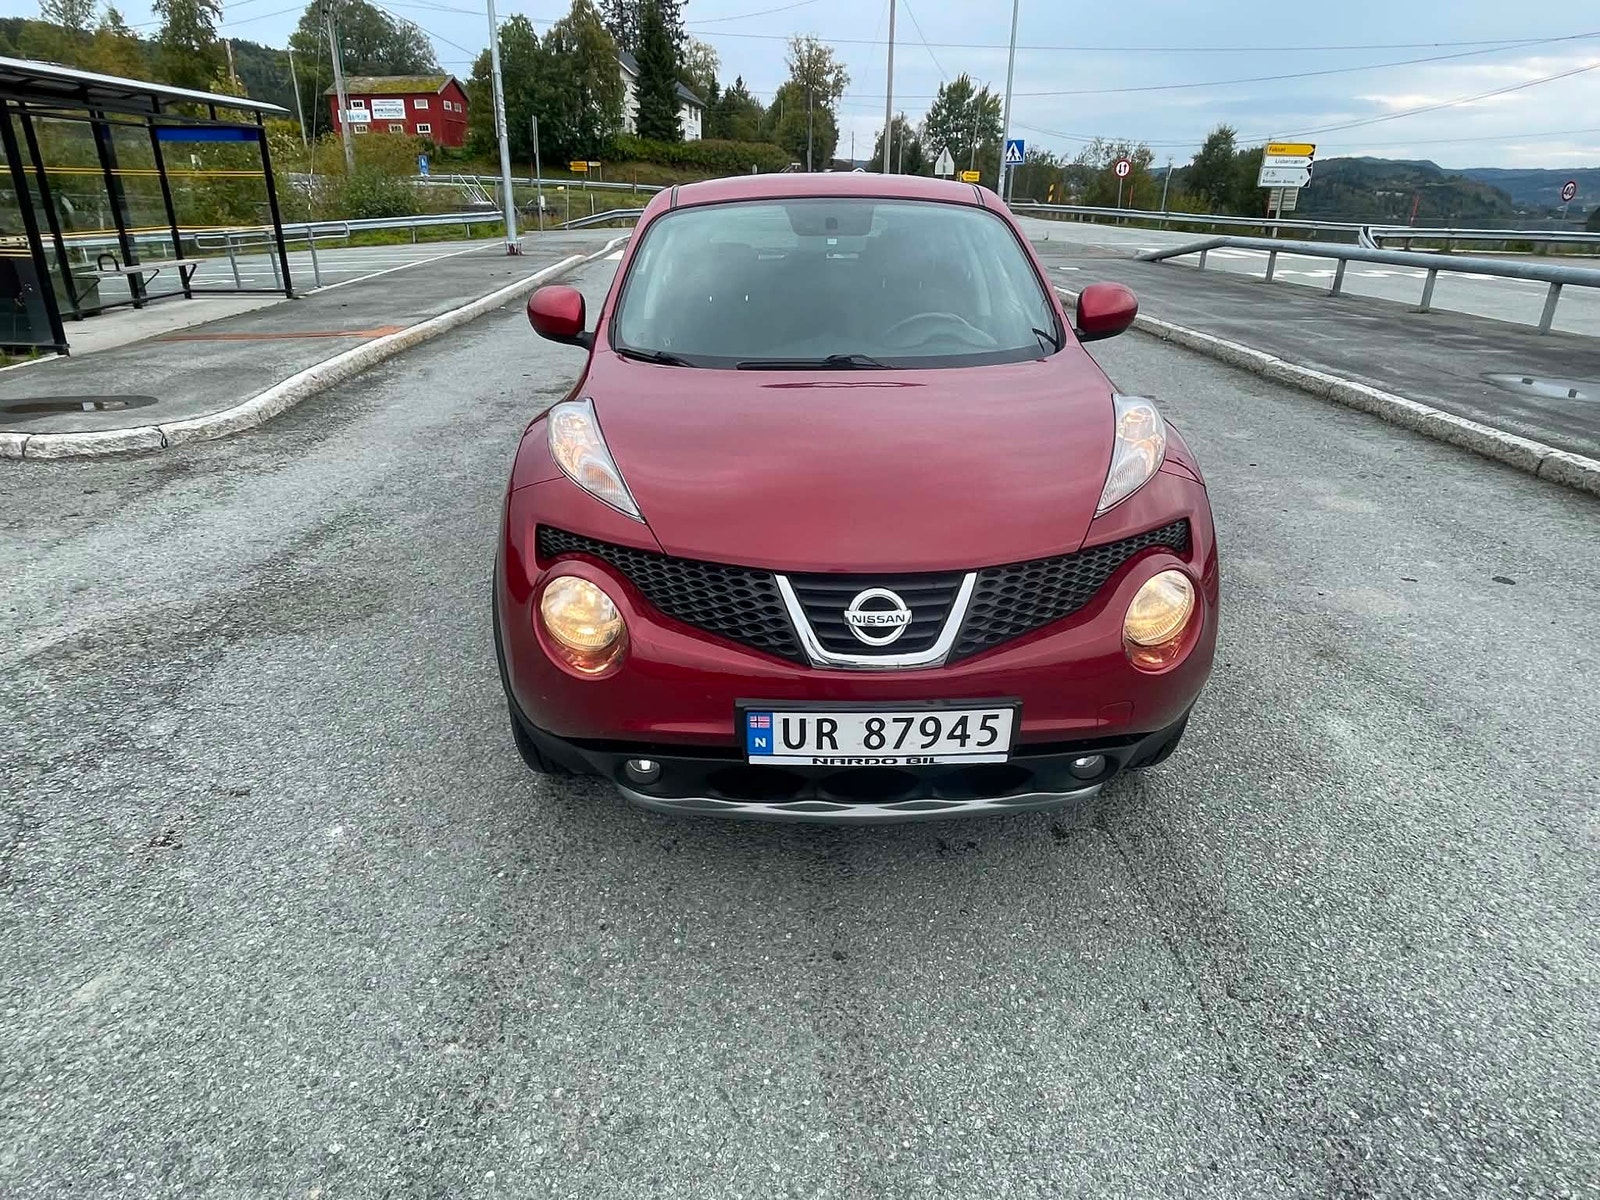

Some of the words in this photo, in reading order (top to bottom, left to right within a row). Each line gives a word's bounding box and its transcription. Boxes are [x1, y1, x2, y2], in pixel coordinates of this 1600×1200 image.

[852, 614, 905, 624] NISSAN
[781, 717, 839, 750] UR
[862, 713, 1000, 750] 87945
[754, 737, 767, 748] N
[812, 757, 898, 765] NARDO
